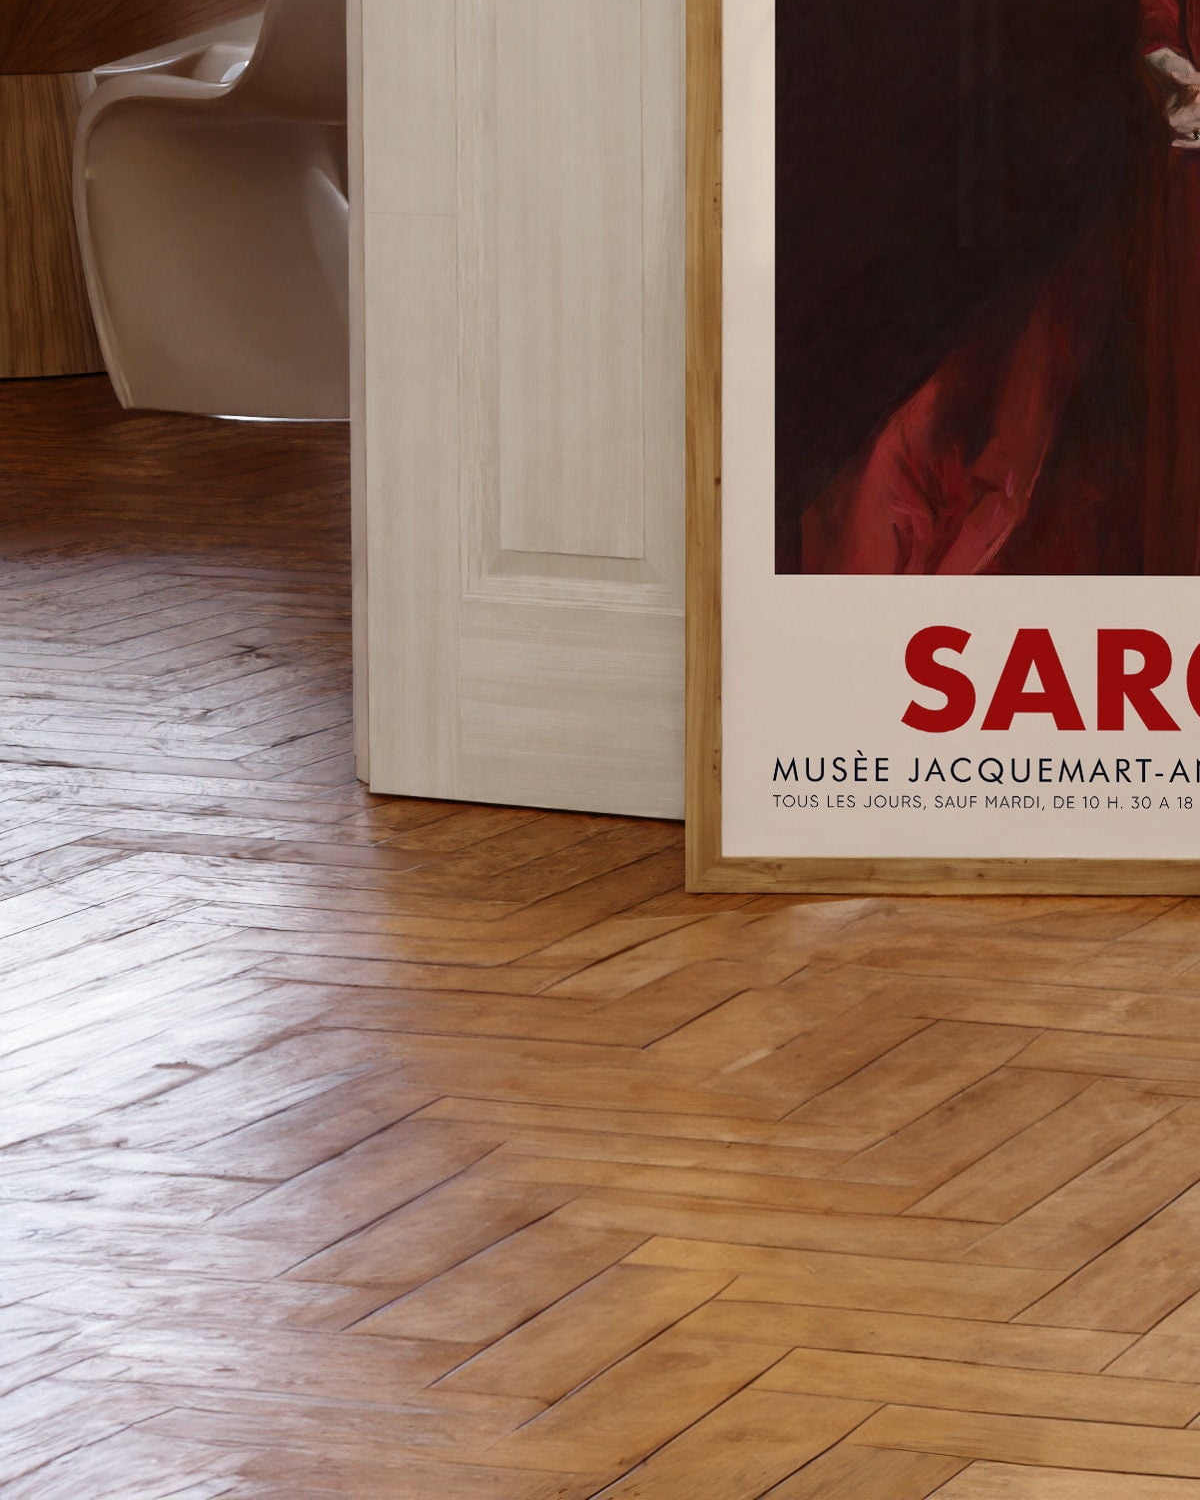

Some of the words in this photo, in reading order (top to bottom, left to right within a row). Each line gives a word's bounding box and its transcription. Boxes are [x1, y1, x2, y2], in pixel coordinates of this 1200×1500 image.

[773, 750, 889, 782] MUSÈE
[773, 795, 819, 809] TOUS
[828, 795, 856, 809] LES
[864, 795, 927, 811] JOURS,
[934, 795, 978, 809] SAUF
[985, 795, 1046, 812] MARDI,
[1054, 796, 1075, 809] DE
[1082, 796, 1100, 809] 10
[1108, 796, 1124, 810] H.
[1131, 796, 1152, 810] 30
[1159, 796, 1170, 809] A
[1177, 796, 1193, 810] 18
